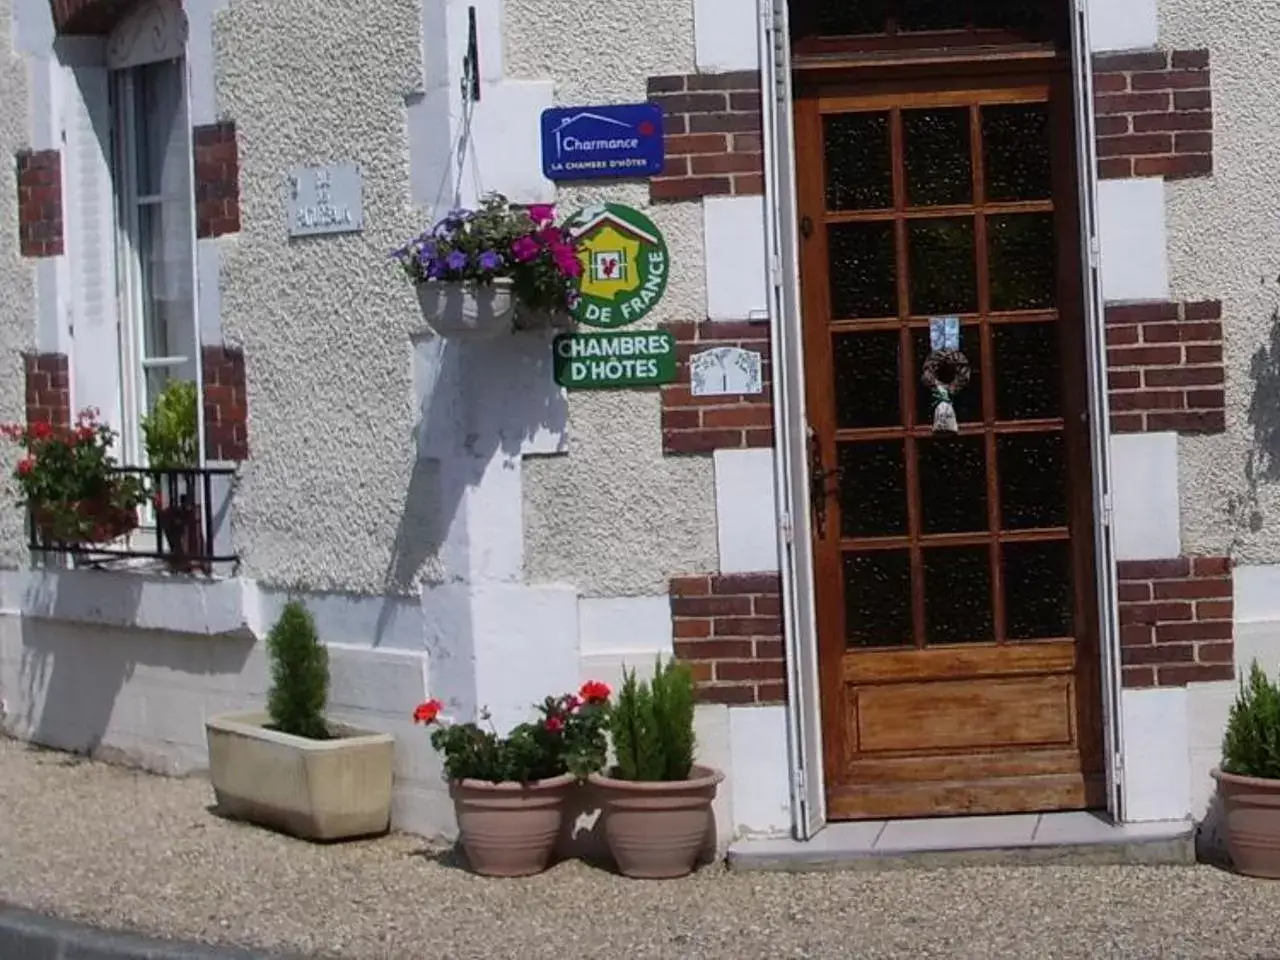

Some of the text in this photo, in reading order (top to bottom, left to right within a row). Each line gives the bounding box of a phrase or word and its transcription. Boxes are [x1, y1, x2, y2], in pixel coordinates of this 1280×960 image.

[563, 136, 639, 151] Charmance
[551, 162, 563, 170] LA
[565, 160, 607, 169] CHAMBRE
[585, 303, 612, 323] DE
[620, 251, 665, 319] FRANCE
[559, 335, 670, 357] CHAMBRES
[571, 357, 658, 380] D'HÔTES
